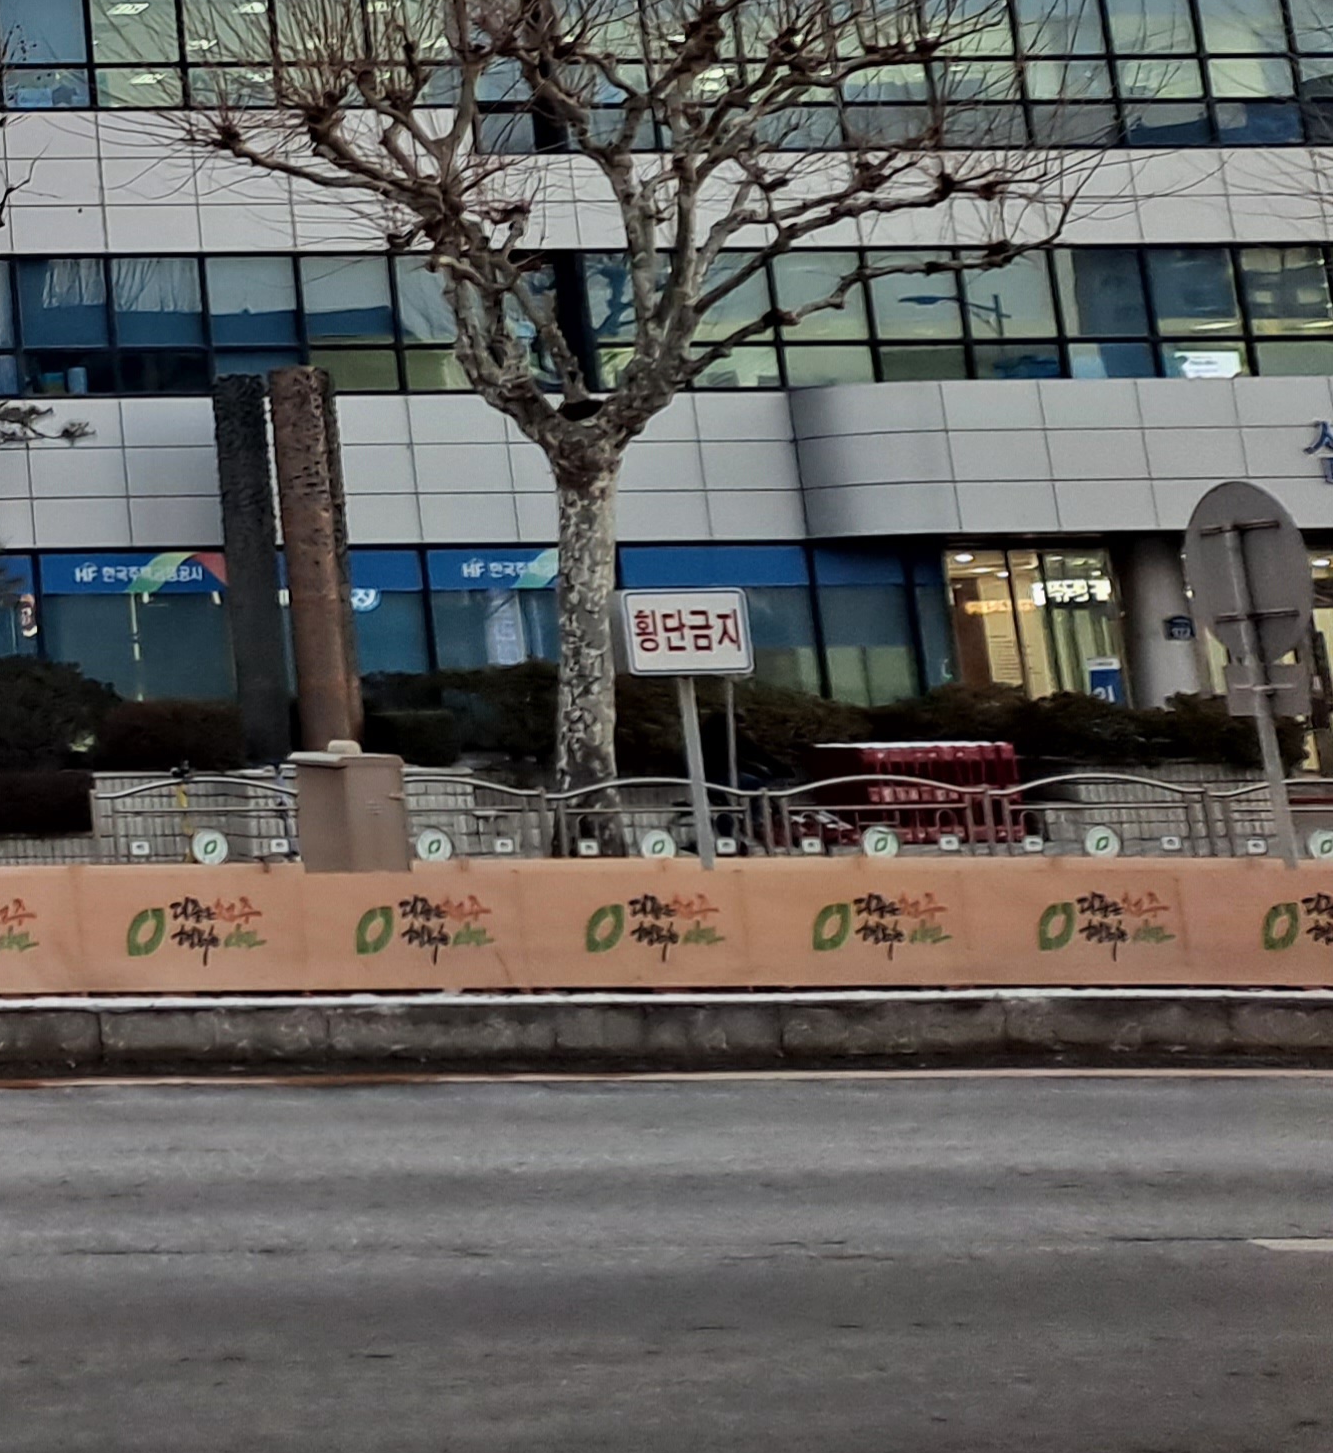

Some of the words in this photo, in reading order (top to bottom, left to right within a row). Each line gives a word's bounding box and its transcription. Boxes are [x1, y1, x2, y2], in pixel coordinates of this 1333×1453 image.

[74, 562, 98, 583] HF
[462, 558, 485, 578] HF
[634, 608, 742, 653] 횡단금지
